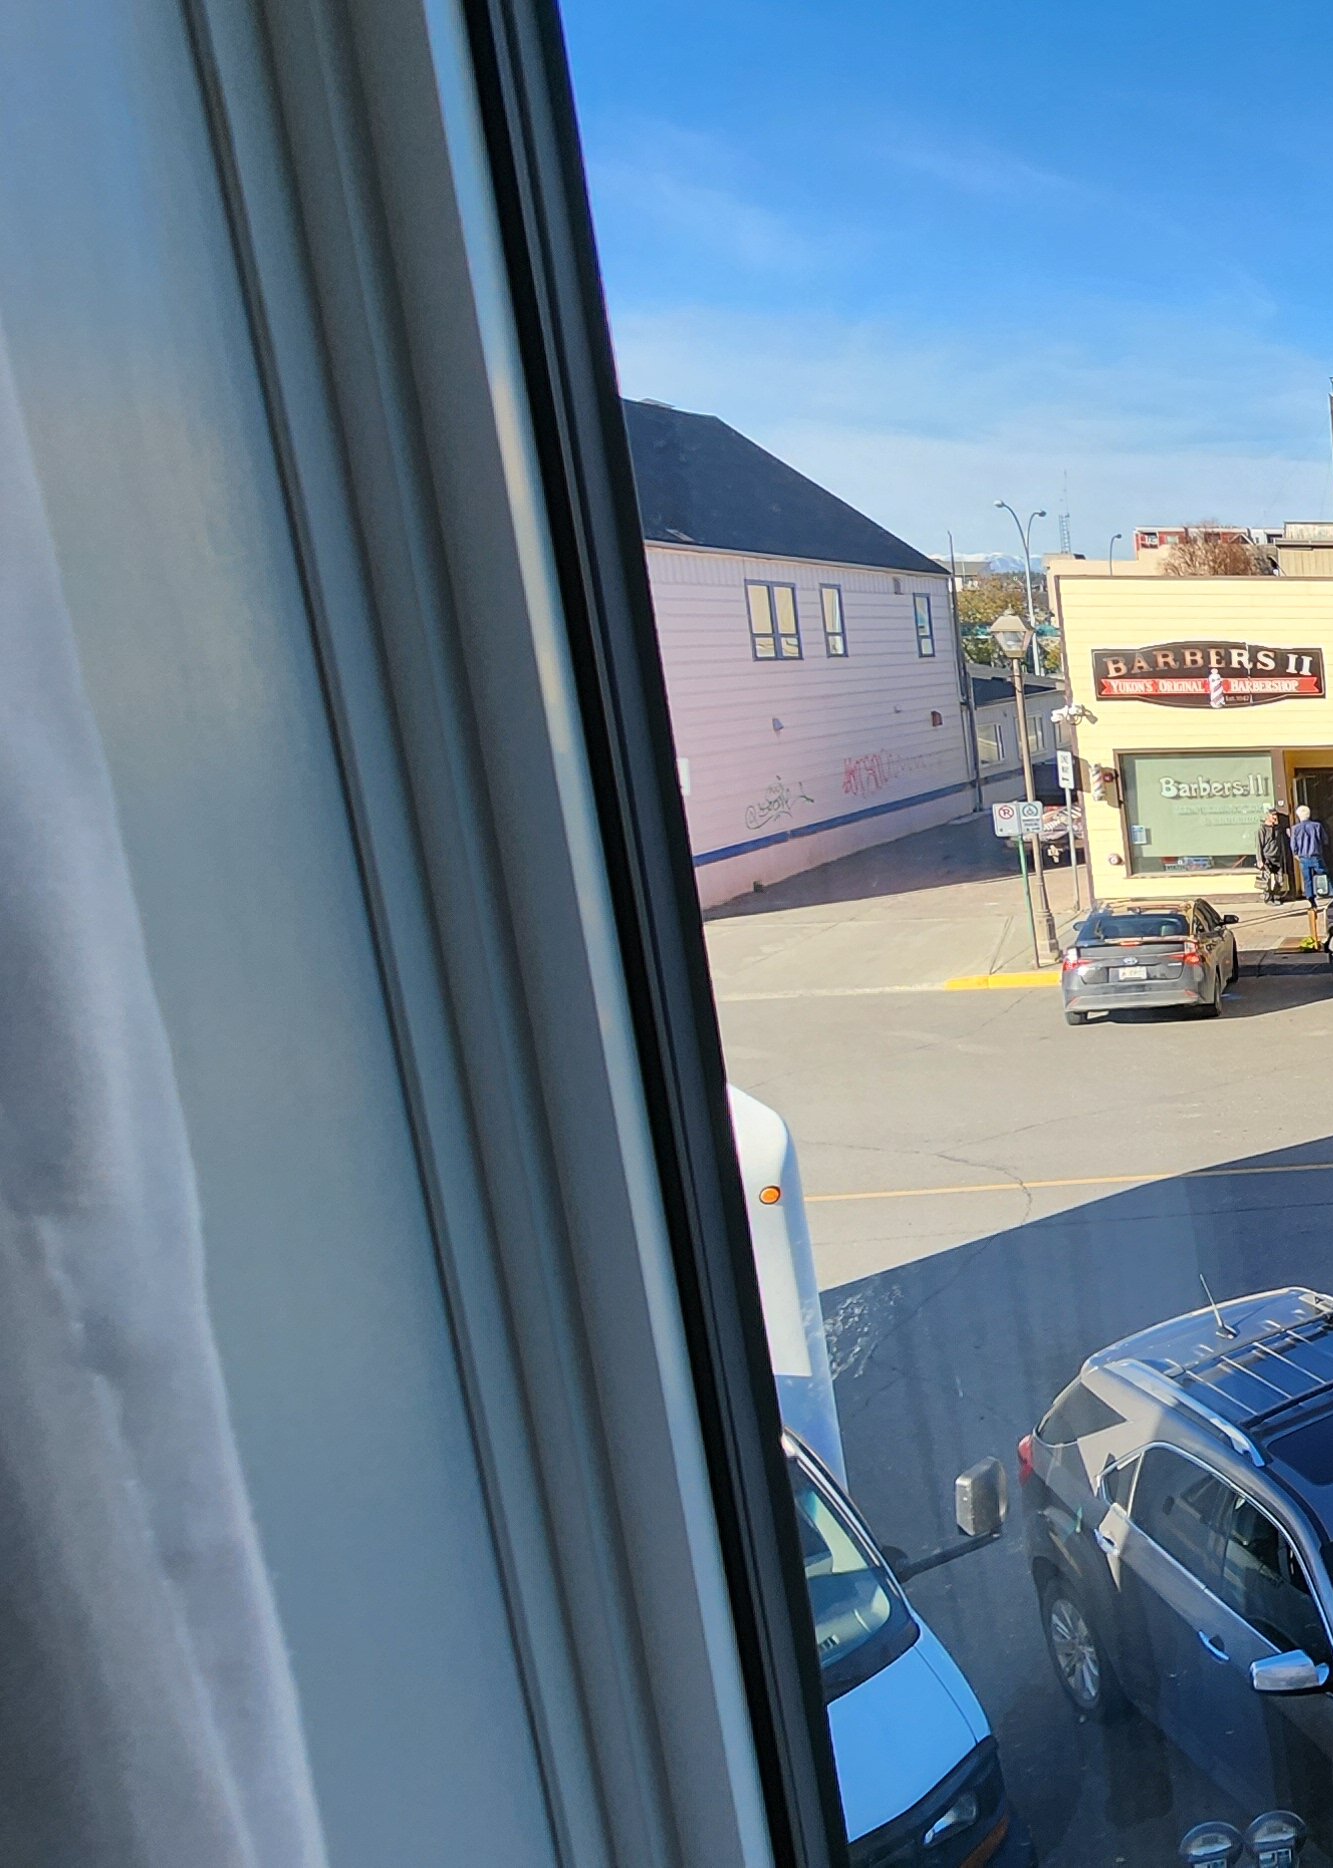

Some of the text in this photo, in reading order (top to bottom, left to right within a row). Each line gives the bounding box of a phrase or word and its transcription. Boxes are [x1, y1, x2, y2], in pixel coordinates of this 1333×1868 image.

[1103, 648, 1313, 677] BARBERS II
[1110, 680, 1299, 692] YUKON'S ORIGINAL BARBERSHOP
[1159, 775, 1245, 799] Barbers
